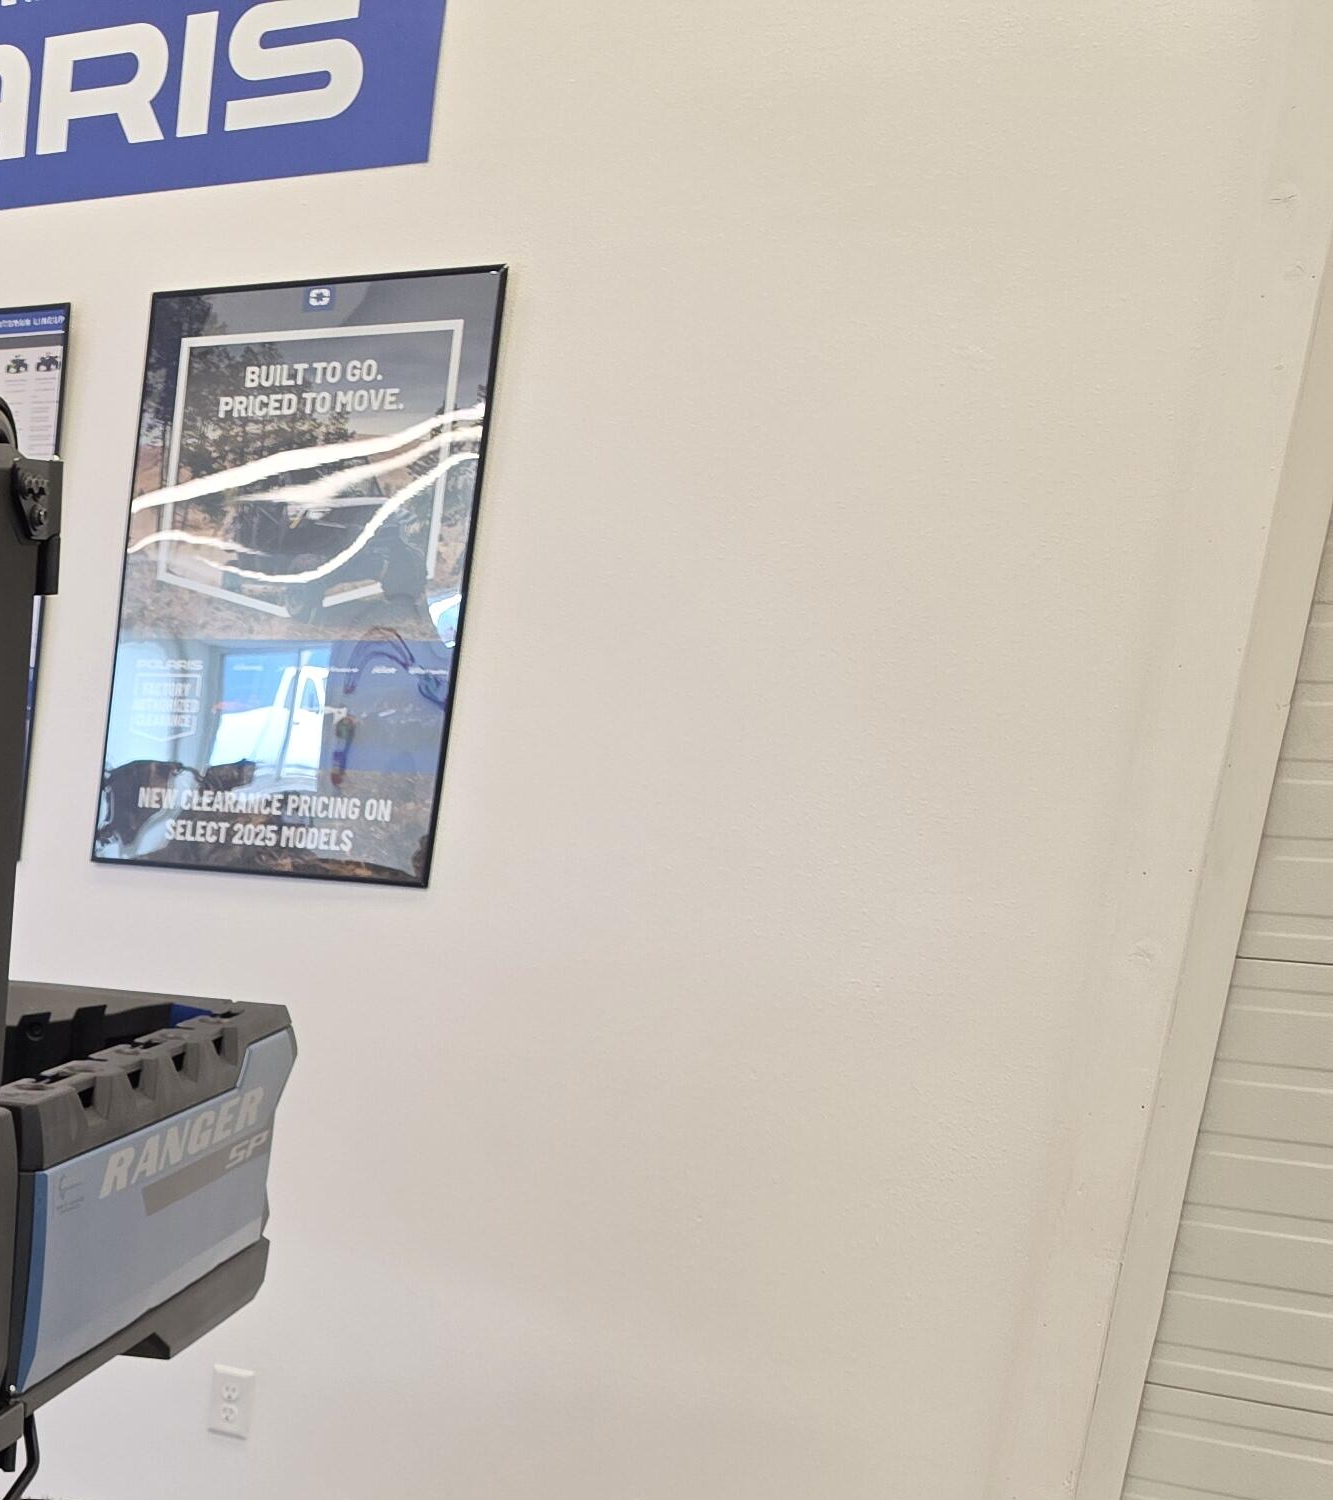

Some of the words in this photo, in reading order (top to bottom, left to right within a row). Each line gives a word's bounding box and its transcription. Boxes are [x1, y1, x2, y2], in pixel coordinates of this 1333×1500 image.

[244, 363, 310, 388] BUILT
[312, 361, 342, 384] TO
[345, 359, 383, 382] GO.
[217, 394, 298, 419] PRICED
[301, 391, 333, 414] TO
[334, 388, 405, 413] MOVE.
[137, 786, 181, 811] NEW
[183, 789, 283, 816] CLEARANCE
[286, 795, 361, 821] PRICING
[364, 798, 393, 823] ON
[164, 819, 230, 844] SELECT
[232, 823, 278, 847] 2025
[280, 825, 354, 853] MODELS
[99, 1086, 265, 1199] RANGER
[224, 1130, 268, 1169] SP
